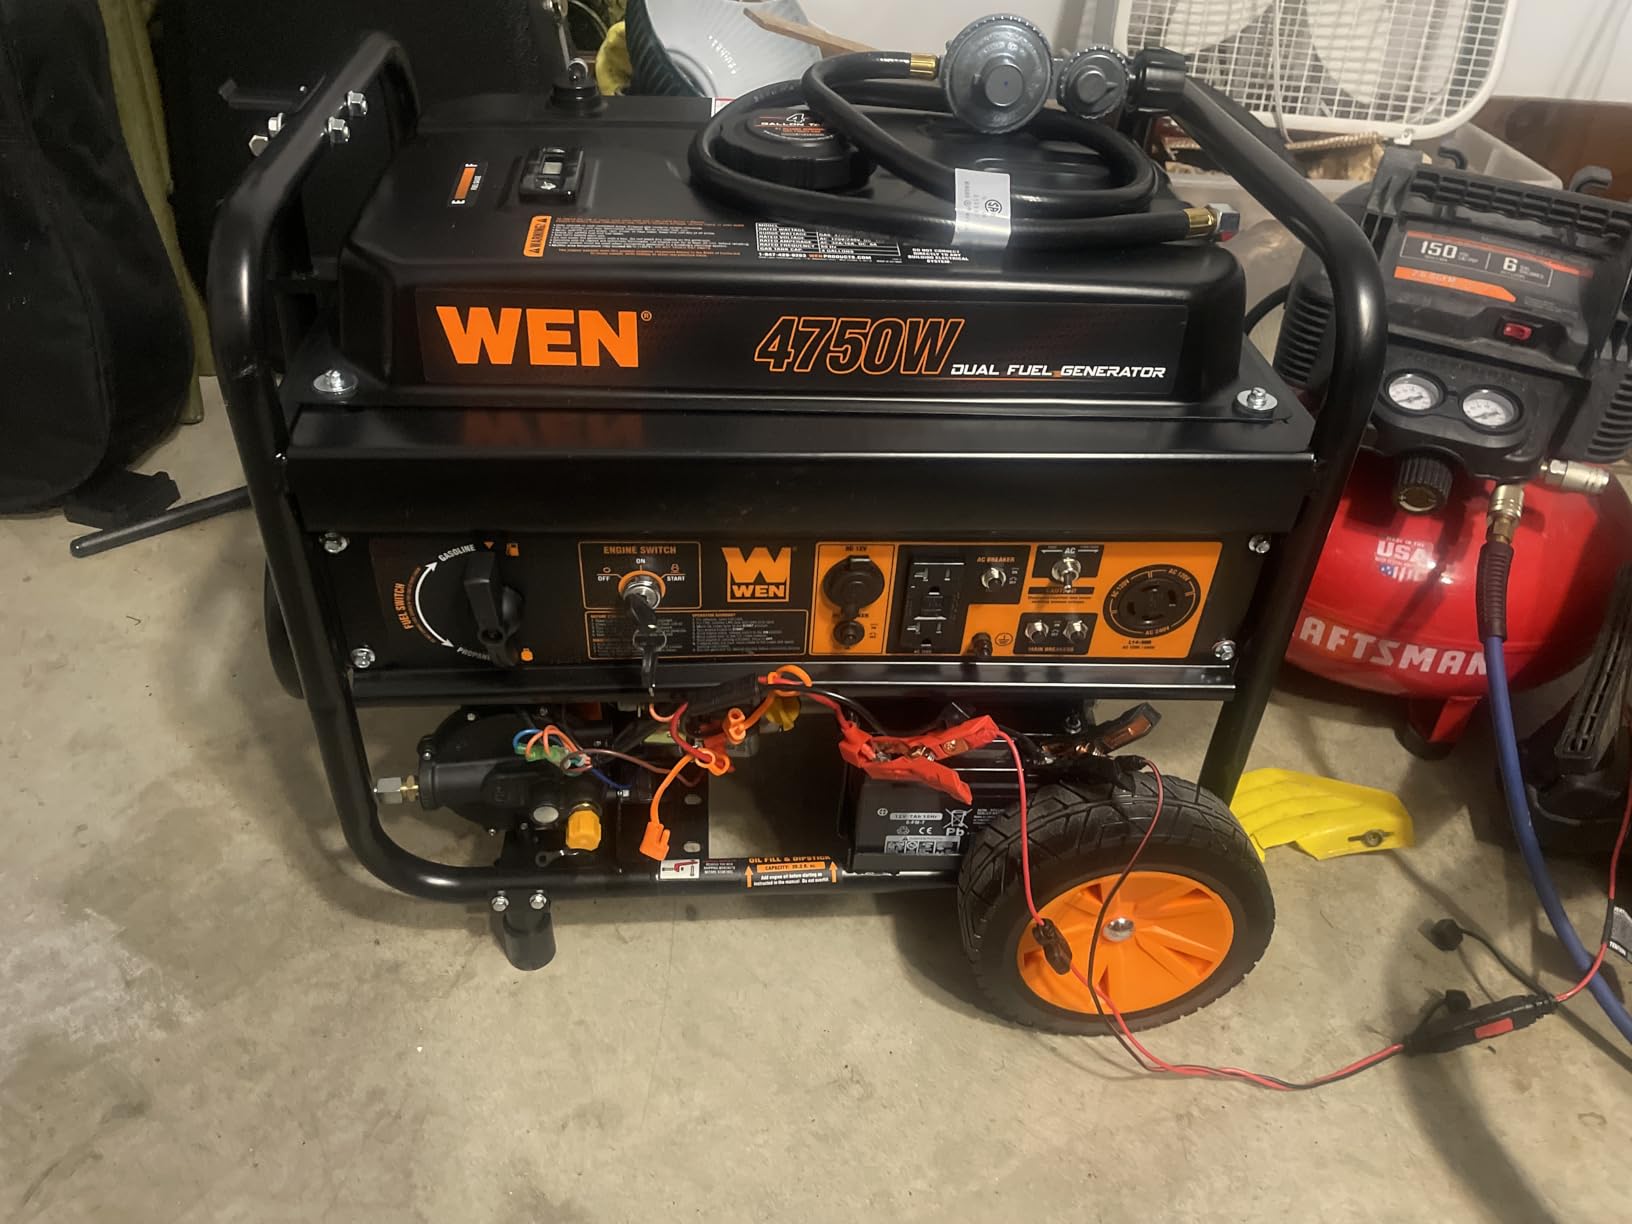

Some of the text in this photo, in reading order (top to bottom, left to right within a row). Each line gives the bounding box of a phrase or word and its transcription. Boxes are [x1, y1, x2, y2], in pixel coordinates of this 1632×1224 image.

[1420, 239, 1458, 260] 150
[1502, 256, 1519, 273] 6
[753, 315, 965, 376] 4750W
[950, 363, 1167, 379] DUAL FUEL GENERATOR
[438, 543, 477, 563] GASOLINE
[603, 545, 677, 555] ENGINE SWITCH
[1064, 547, 1076, 555] AC
[1376, 540, 1428, 562] USA
[393, 582, 407, 612] SWITCH
[732, 585, 785, 598] WEN
[398, 612, 415, 631] FUEL
[946, 827, 965, 837] Pb
